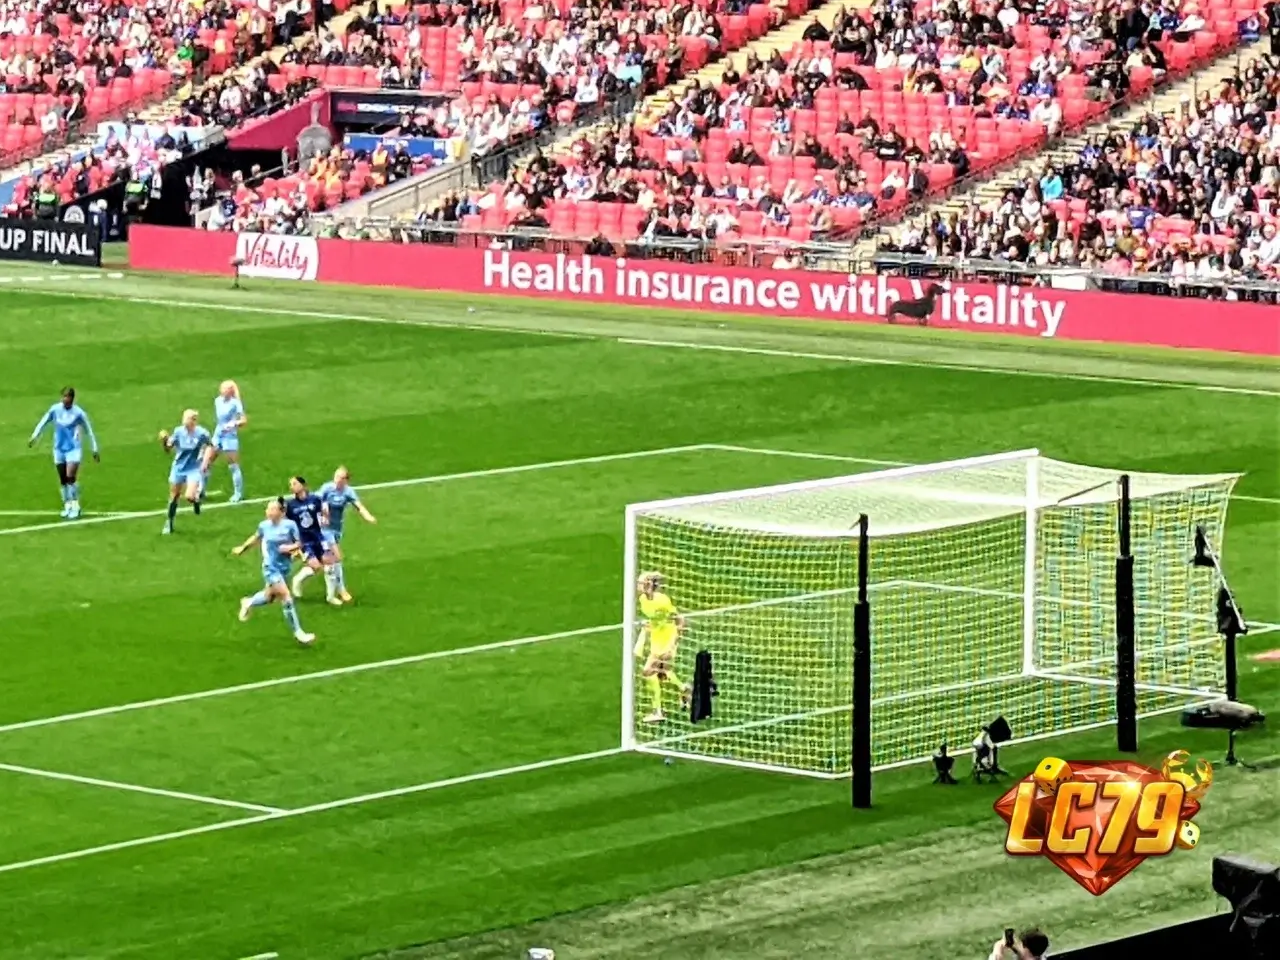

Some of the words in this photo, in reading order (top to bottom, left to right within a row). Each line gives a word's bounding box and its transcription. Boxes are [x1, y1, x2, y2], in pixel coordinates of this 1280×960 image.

[32, 229, 95, 256] FINAL
[245, 231, 309, 280] Vitality
[483, 249, 604, 295] Health
[615, 257, 801, 309] insurance
